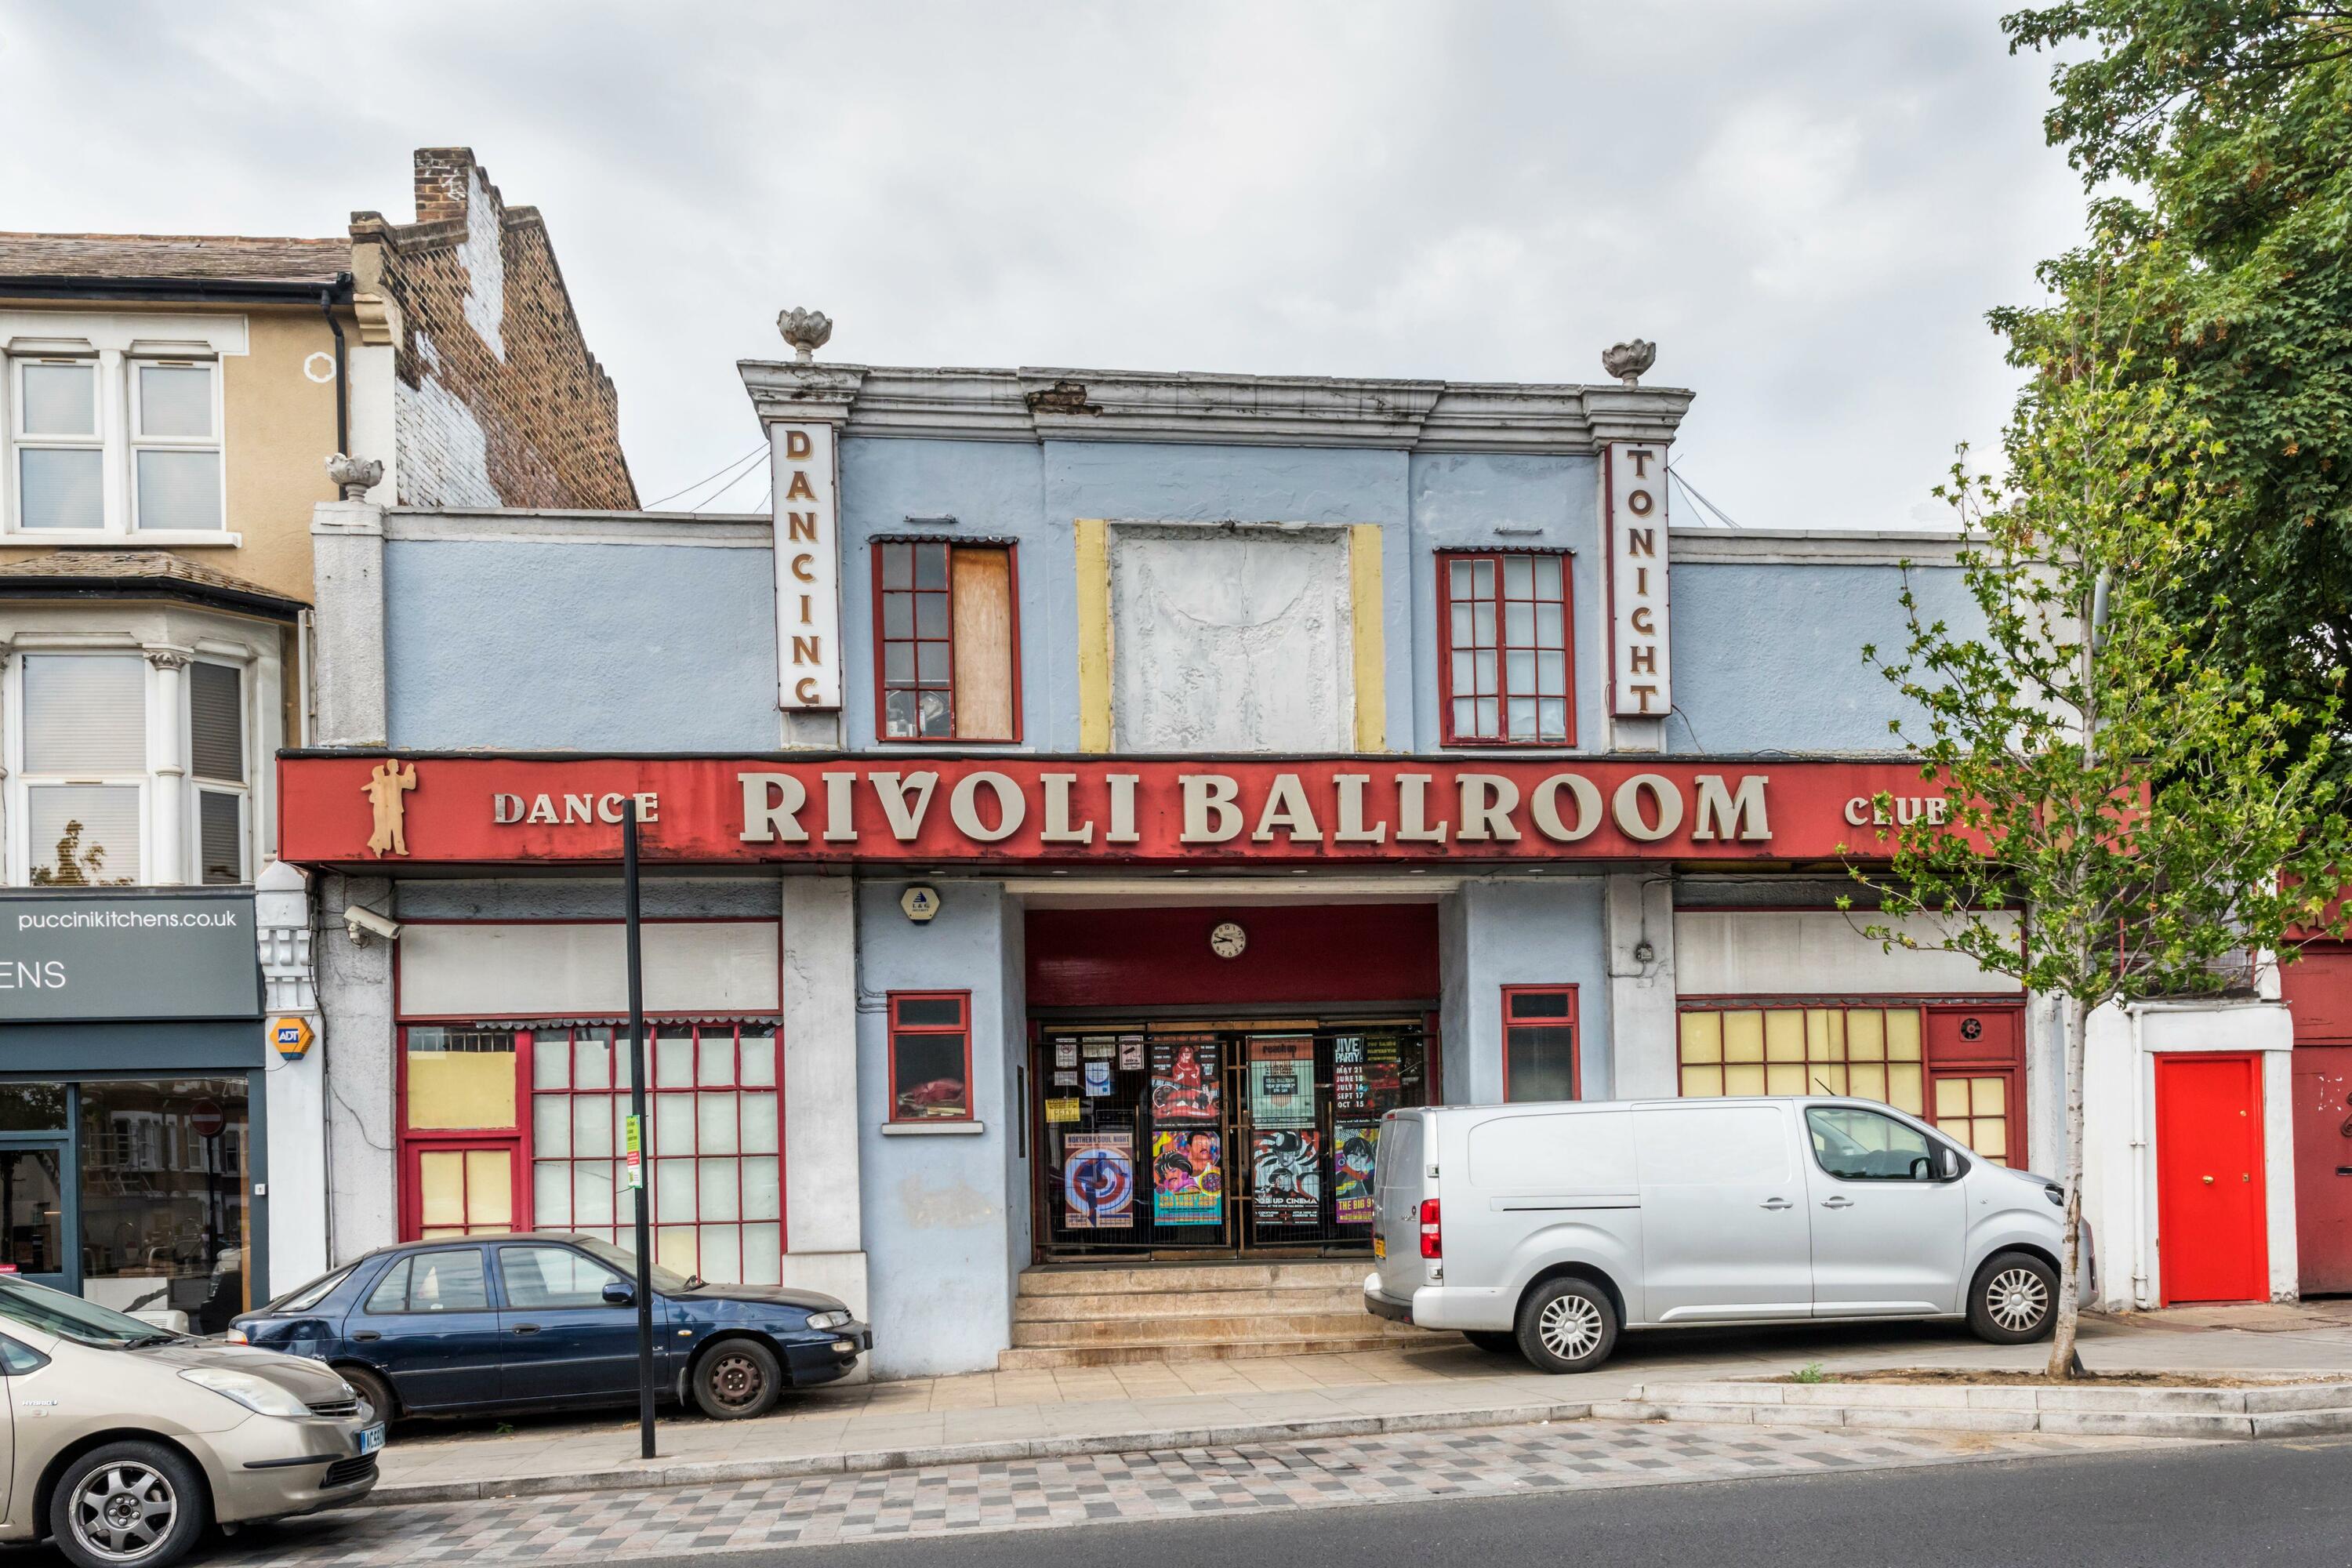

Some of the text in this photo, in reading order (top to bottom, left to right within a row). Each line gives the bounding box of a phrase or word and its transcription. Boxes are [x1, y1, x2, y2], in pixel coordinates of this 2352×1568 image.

[785, 430, 821, 705] DANCING
[1627, 450, 1657, 713] TONIGHT
[492, 793, 659, 824] DANCE
[738, 771, 1773, 844] RIVOLI BALLROOM
[19, 910, 237, 931] puccinikitchens.co.uk
[278, 1030, 299, 1041] ADT
[1335, 1037, 1359, 1053] JIVE
[1338, 1200, 1352, 1210] THE
[1353, 1199, 1364, 1209] BIG
